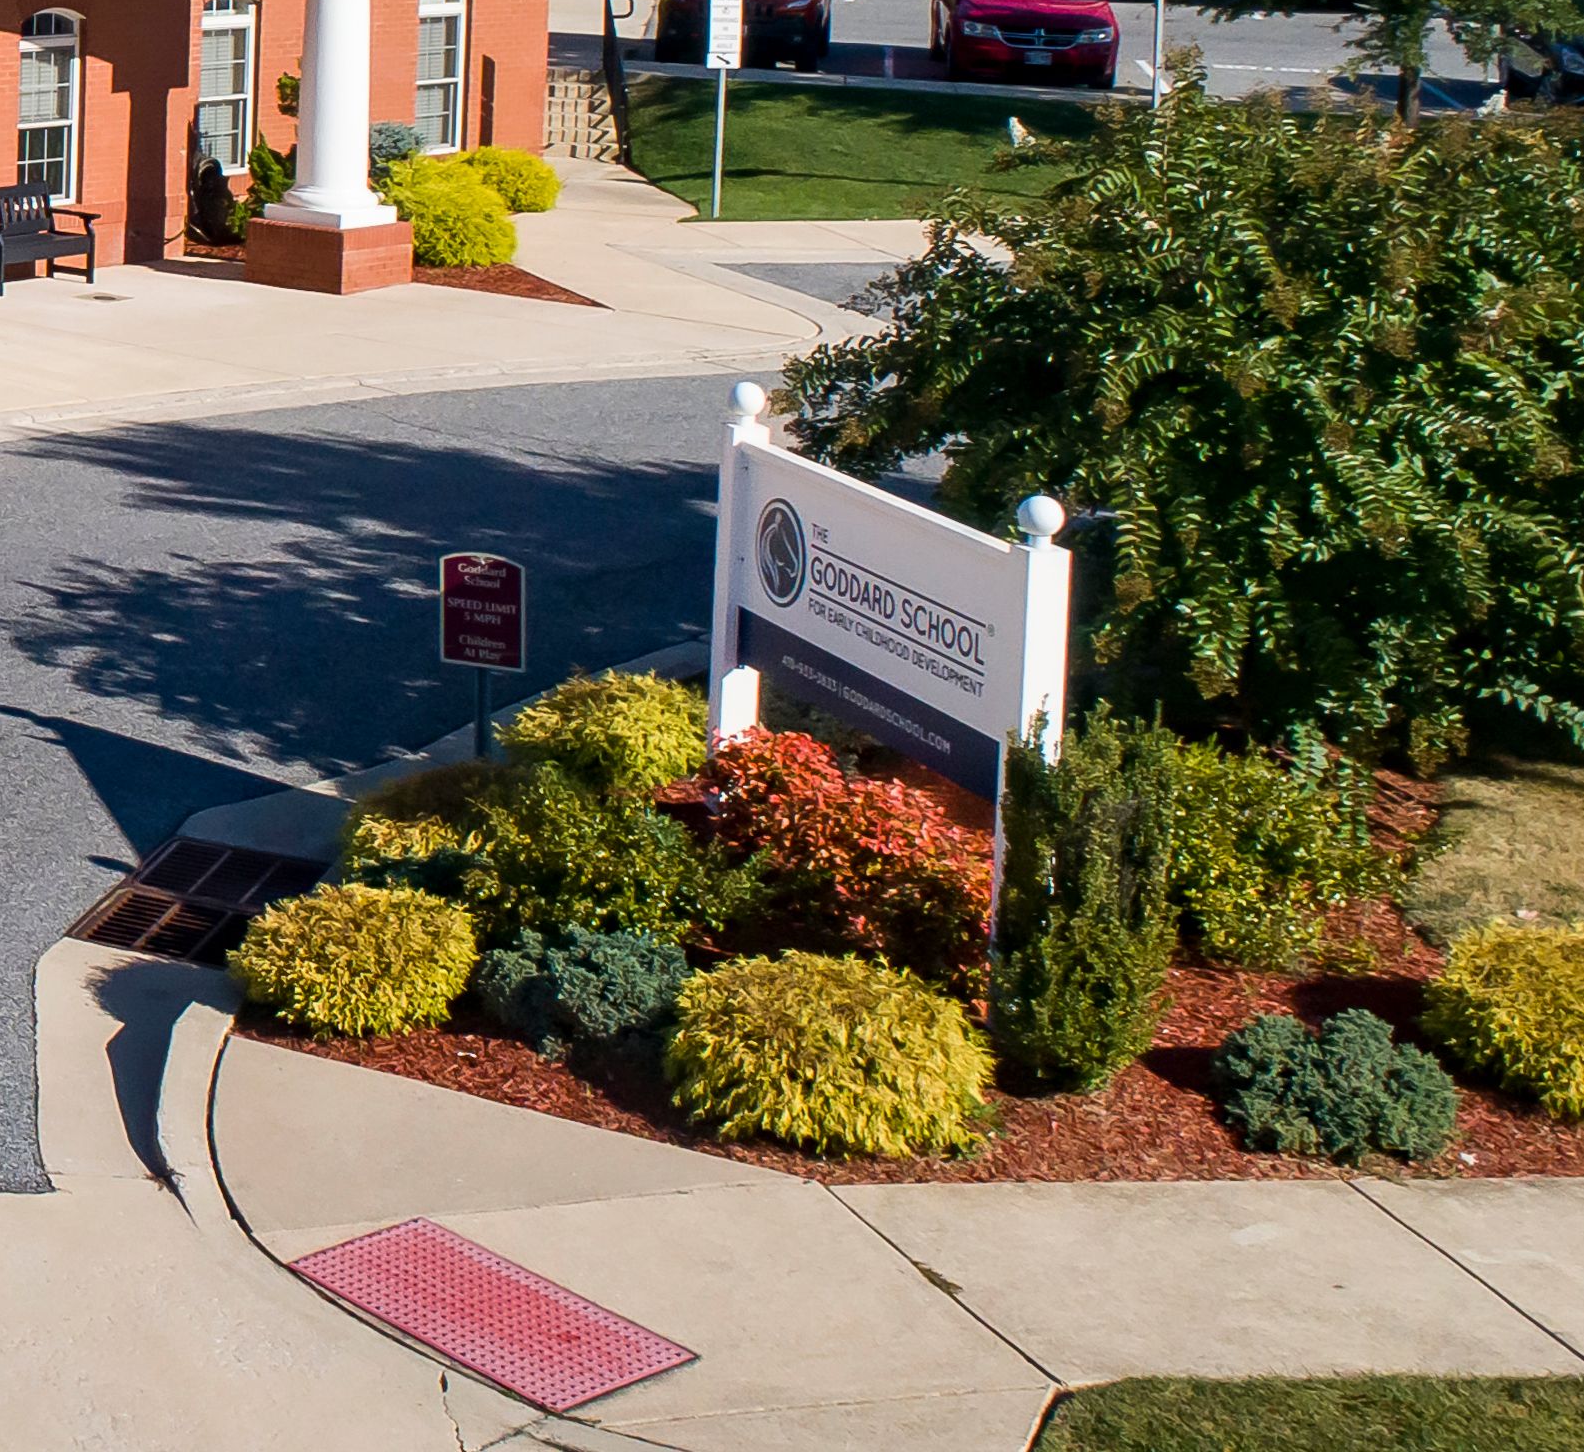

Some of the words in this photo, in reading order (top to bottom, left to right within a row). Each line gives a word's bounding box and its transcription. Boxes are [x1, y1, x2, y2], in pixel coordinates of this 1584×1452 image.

[811, 523, 829, 544] THE
[457, 562, 507, 578] Goddard
[463, 575, 501, 588] School
[810, 556, 896, 620] GODDARD
[447, 596, 482, 610] SPEED
[485, 601, 517, 615] LIMIT
[473, 612, 502, 625] MPH
[458, 634, 507, 649] Children
[808, 596, 827, 616] FOR
[827, 605, 854, 632] EARLY
[855, 621, 911, 661] CHILDHOOD
[911, 649, 985, 698] DEVELOPMENT
